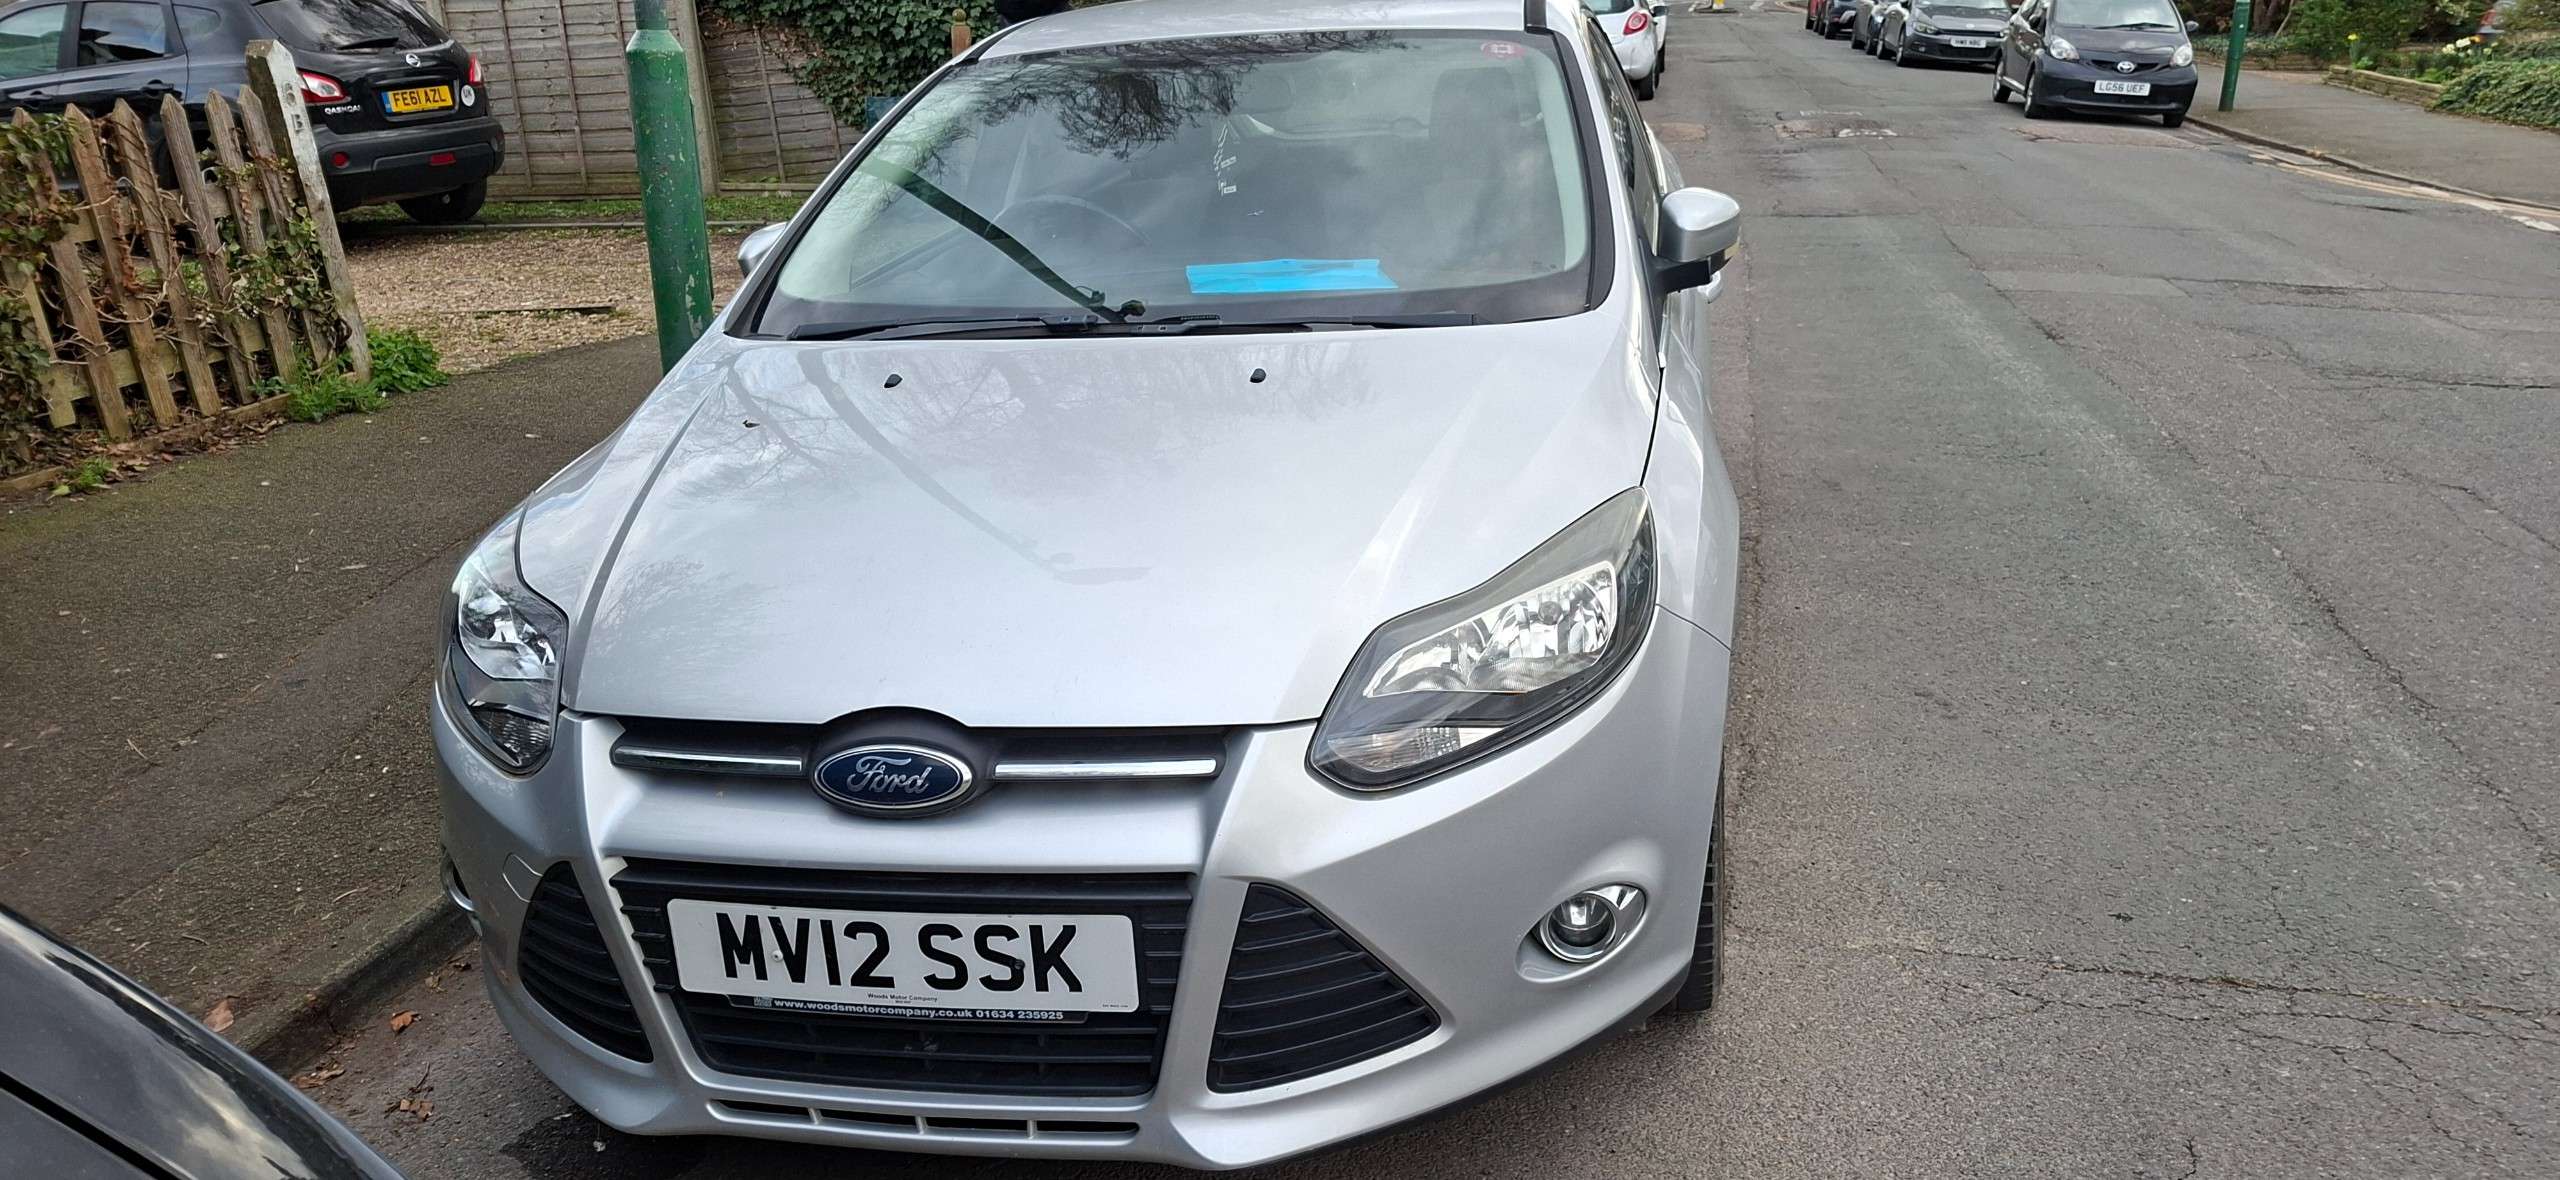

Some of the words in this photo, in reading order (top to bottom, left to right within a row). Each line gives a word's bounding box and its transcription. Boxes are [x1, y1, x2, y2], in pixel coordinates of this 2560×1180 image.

[2099, 81, 2124, 92] LG56
[393, 89, 422, 107] FE61
[424, 88, 447, 104] AZL
[847, 755, 932, 794] Ford
[716, 912, 895, 989] MV12
[918, 923, 1082, 993] SSK
[774, 999, 972, 1017] www.woodsmotorcompany.co.uk
[976, 1010, 1014, 1018] 01634
[1017, 1011, 1064, 1020] 235925
